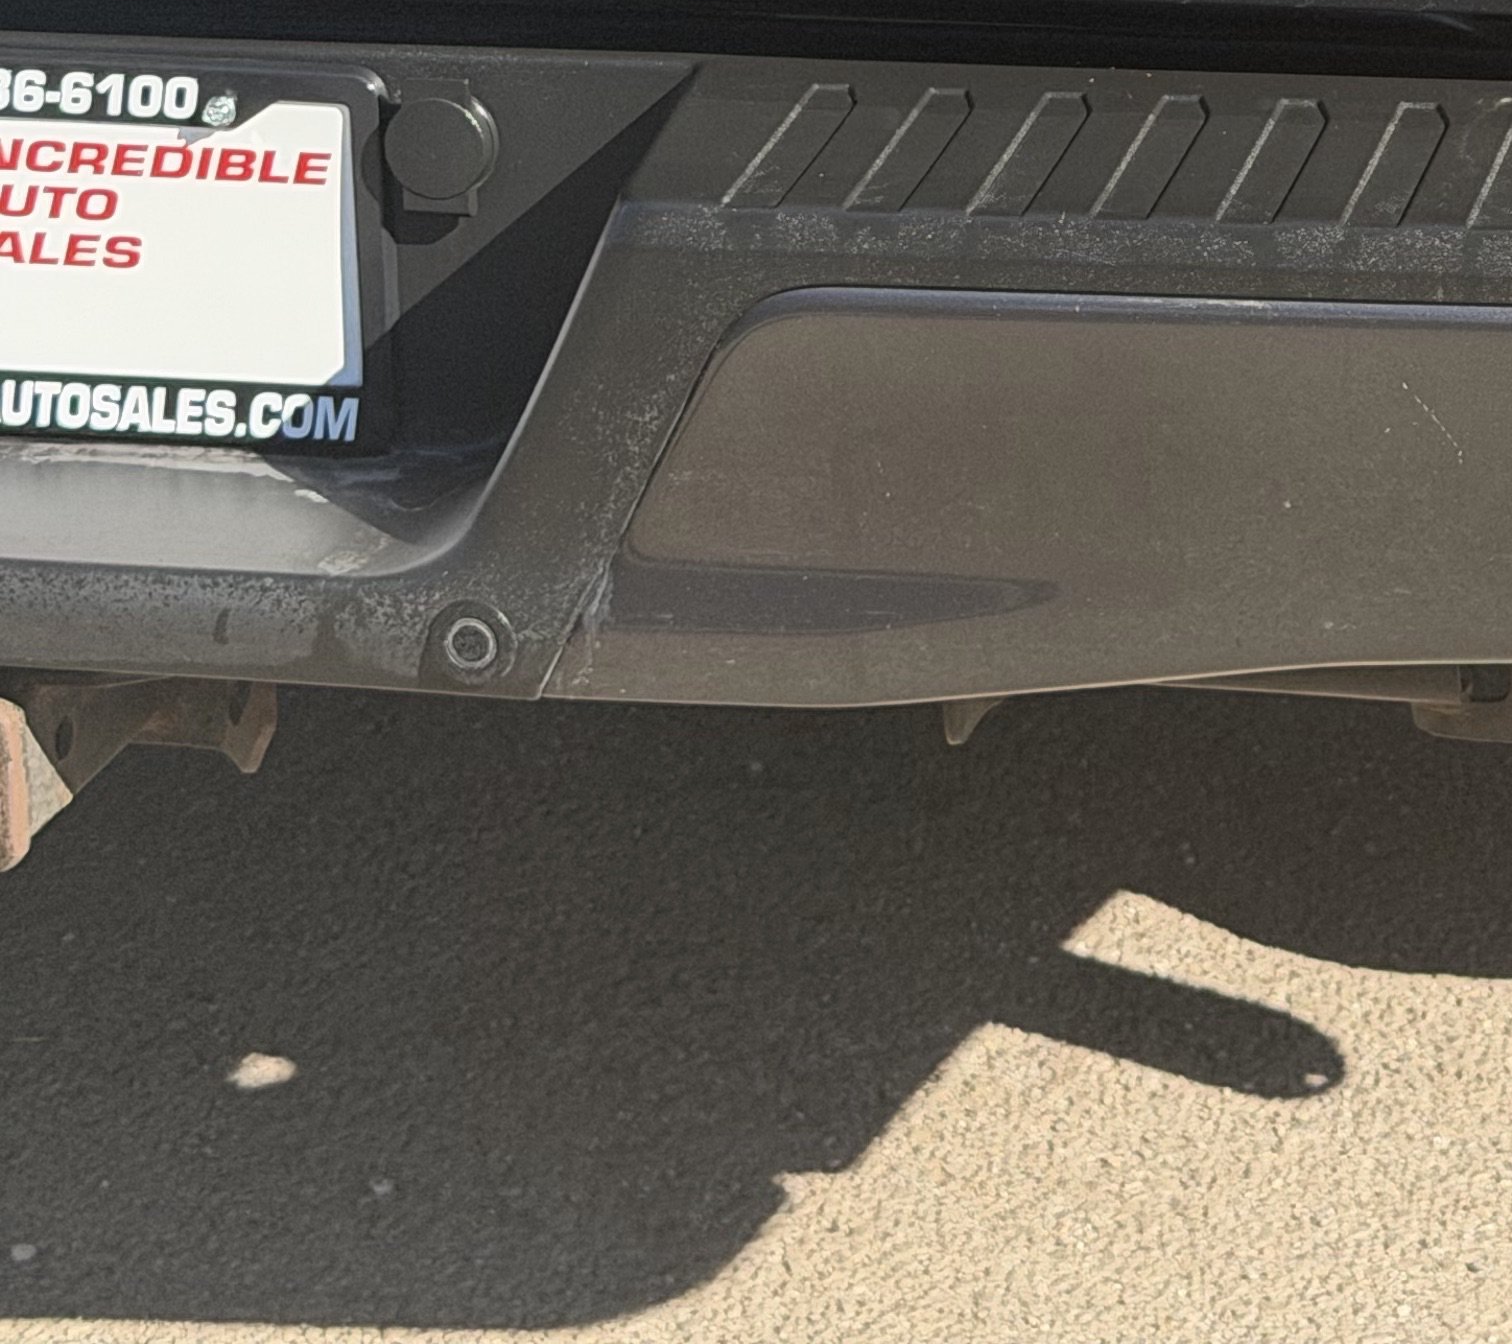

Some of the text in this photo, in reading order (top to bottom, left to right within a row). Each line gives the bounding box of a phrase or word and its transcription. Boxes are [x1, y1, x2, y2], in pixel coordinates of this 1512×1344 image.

[0, 138, 332, 185] NCREDIBLE
[0, 184, 118, 221] UTO
[0, 379, 360, 441] UTOSALES.COM
